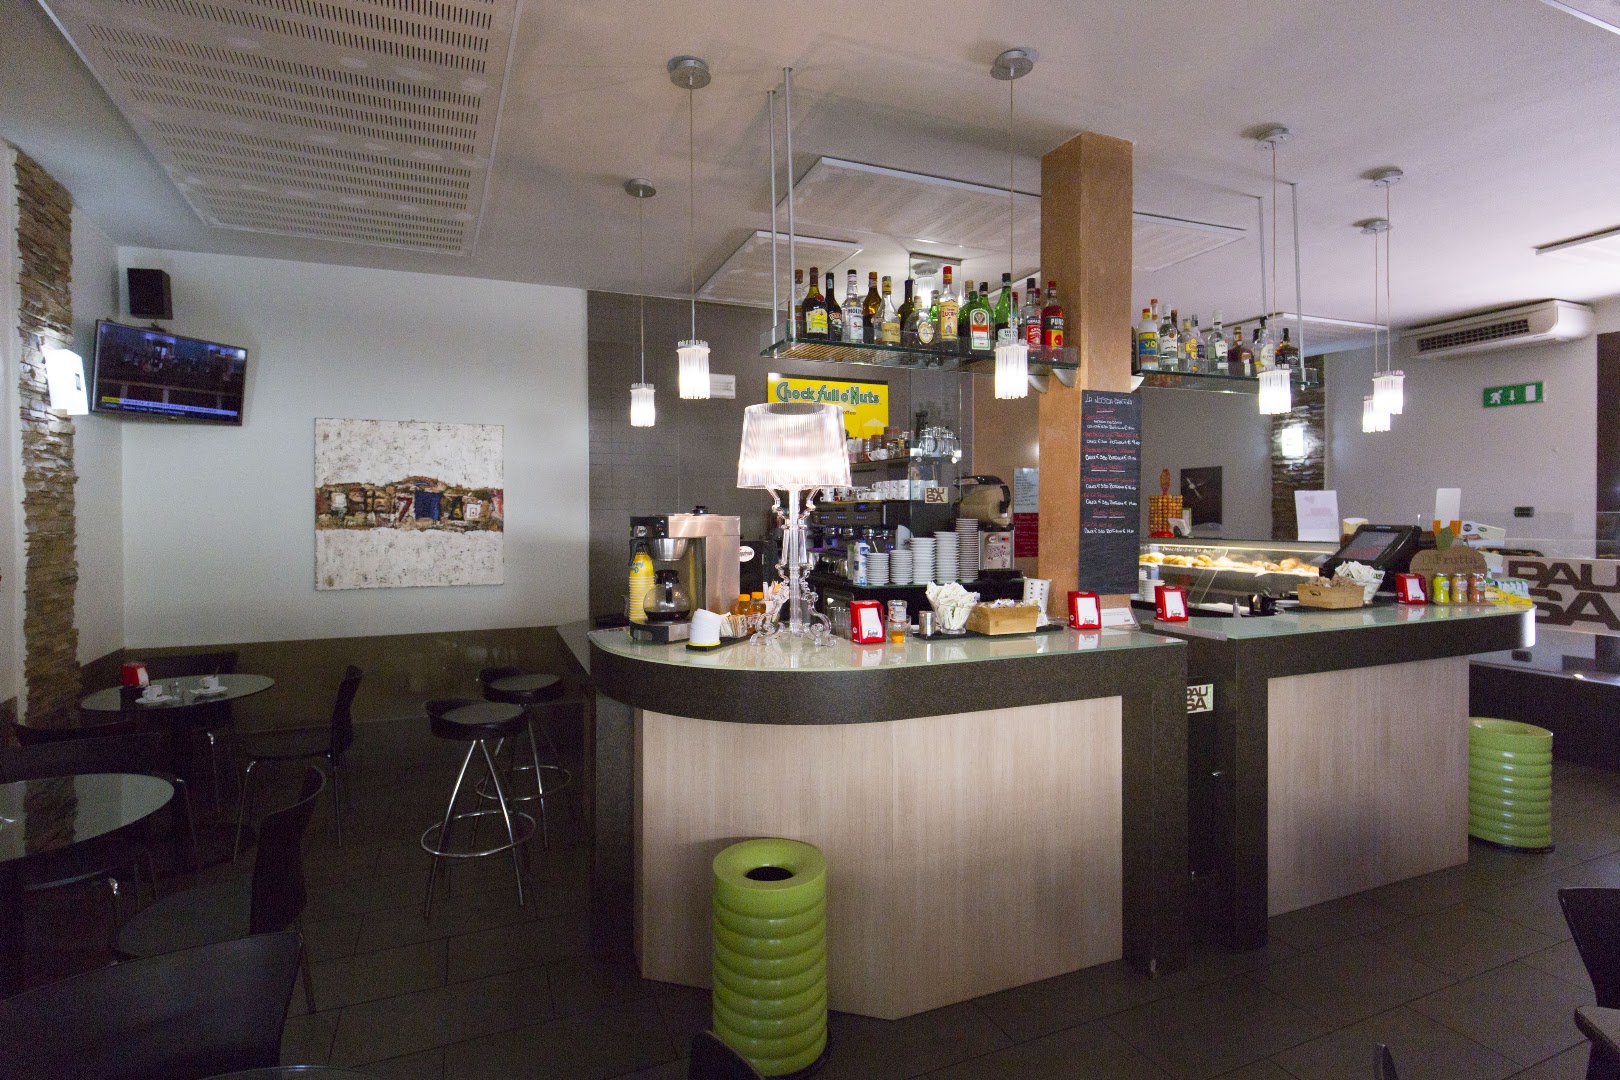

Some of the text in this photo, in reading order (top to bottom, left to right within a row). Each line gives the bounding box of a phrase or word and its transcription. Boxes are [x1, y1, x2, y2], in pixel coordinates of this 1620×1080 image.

[776, 381, 816, 403] Chock
[814, 384, 840, 404] full
[926, 487, 945, 495] PAU
[926, 494, 945, 503] SA
[1508, 560, 1620, 594] PAU
